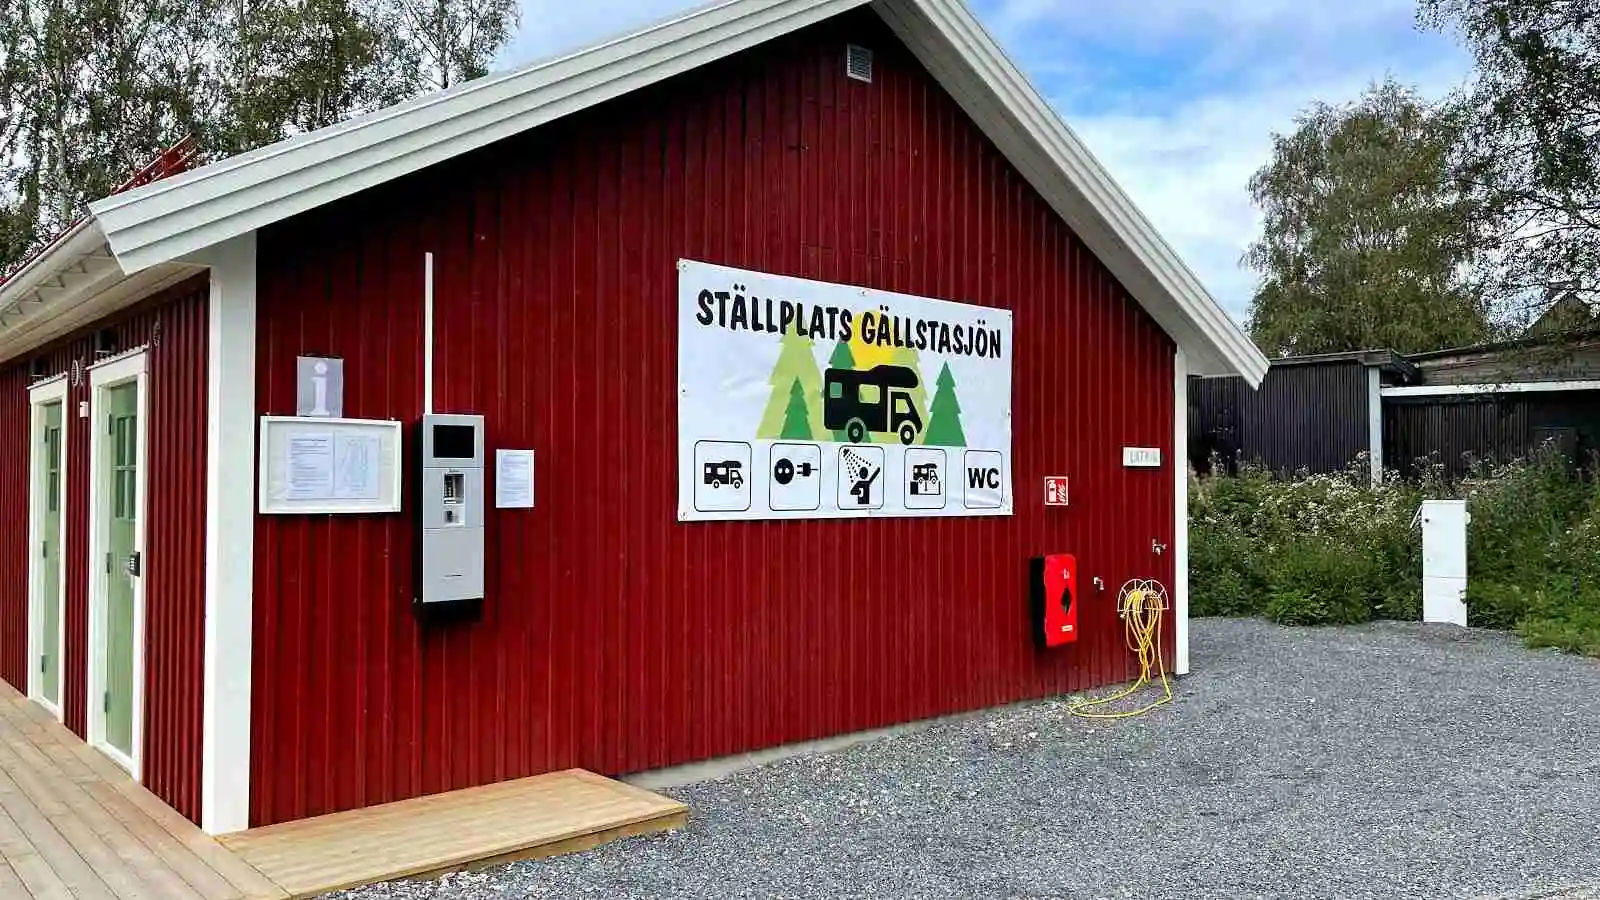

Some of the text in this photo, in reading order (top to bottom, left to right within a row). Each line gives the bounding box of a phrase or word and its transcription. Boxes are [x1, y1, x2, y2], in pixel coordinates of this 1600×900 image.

[696, 283, 1002, 359] STÄLLPLATS GÄLLSTASJÖN
[967, 467, 1000, 490] WC
